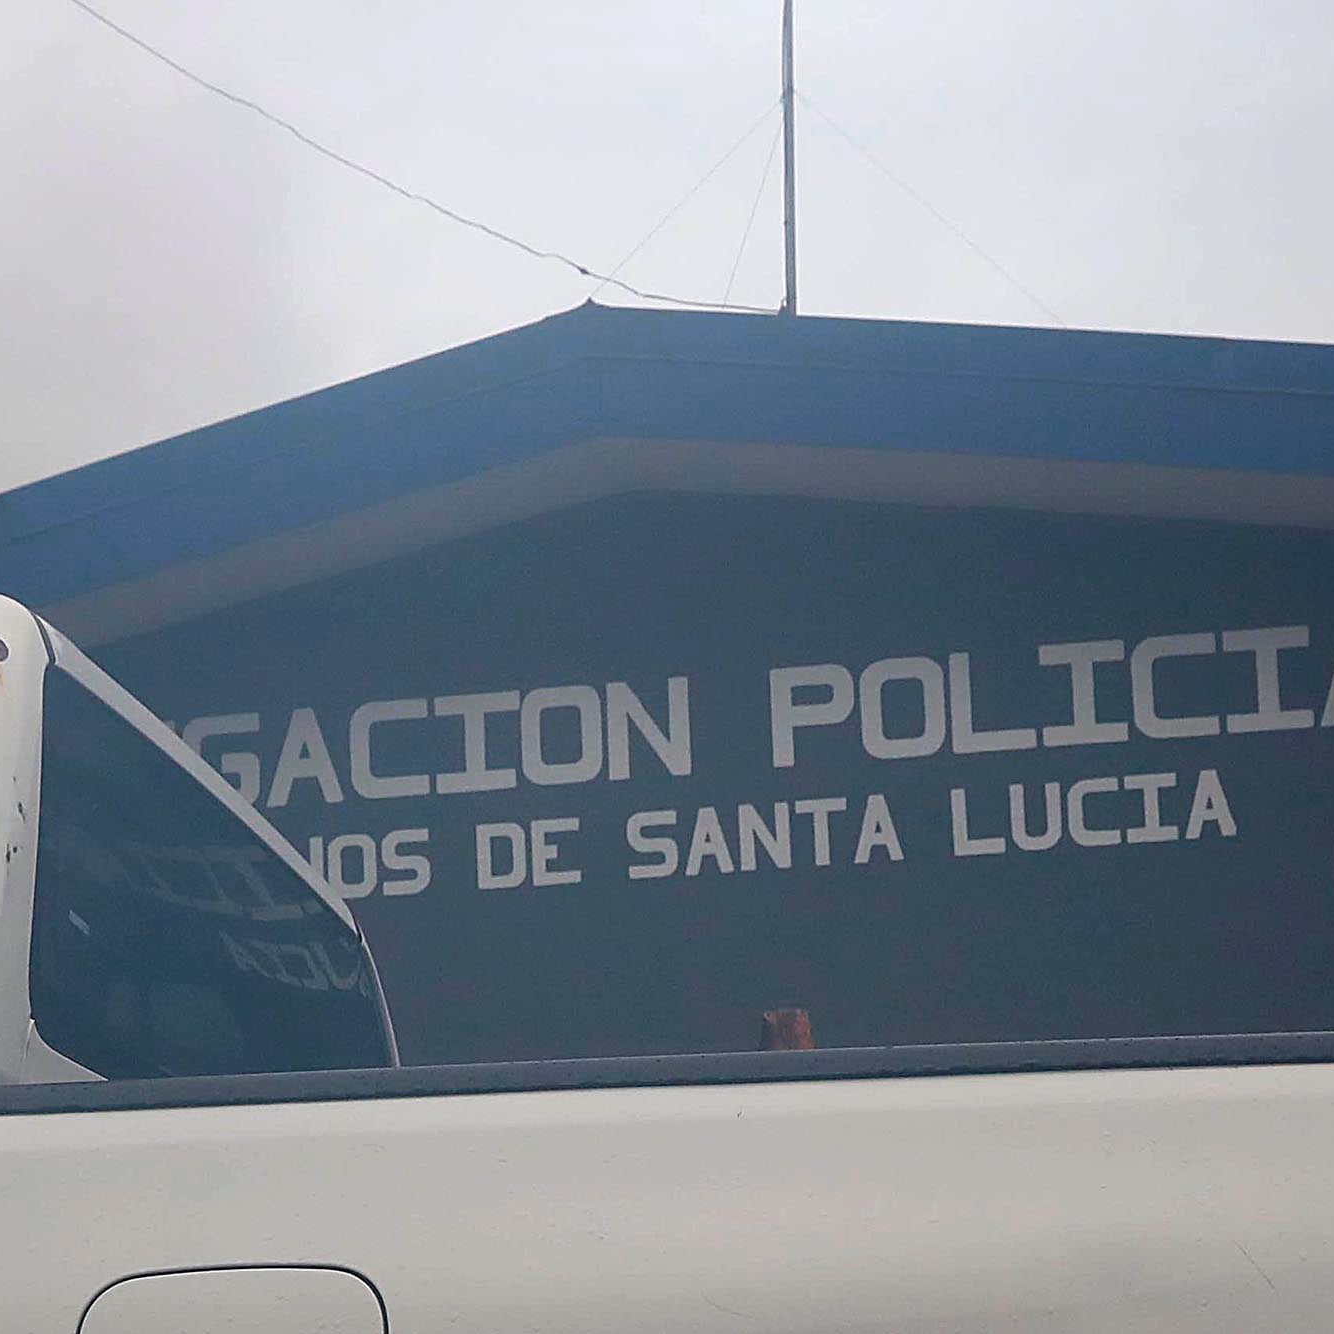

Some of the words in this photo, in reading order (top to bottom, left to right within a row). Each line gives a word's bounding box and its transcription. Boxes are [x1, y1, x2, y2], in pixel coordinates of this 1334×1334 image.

[165, 676, 692, 808] GACION
[476, 817, 582, 891] DE
[626, 794, 905, 880] SANTA
[950, 770, 1238, 857] LUCIA
